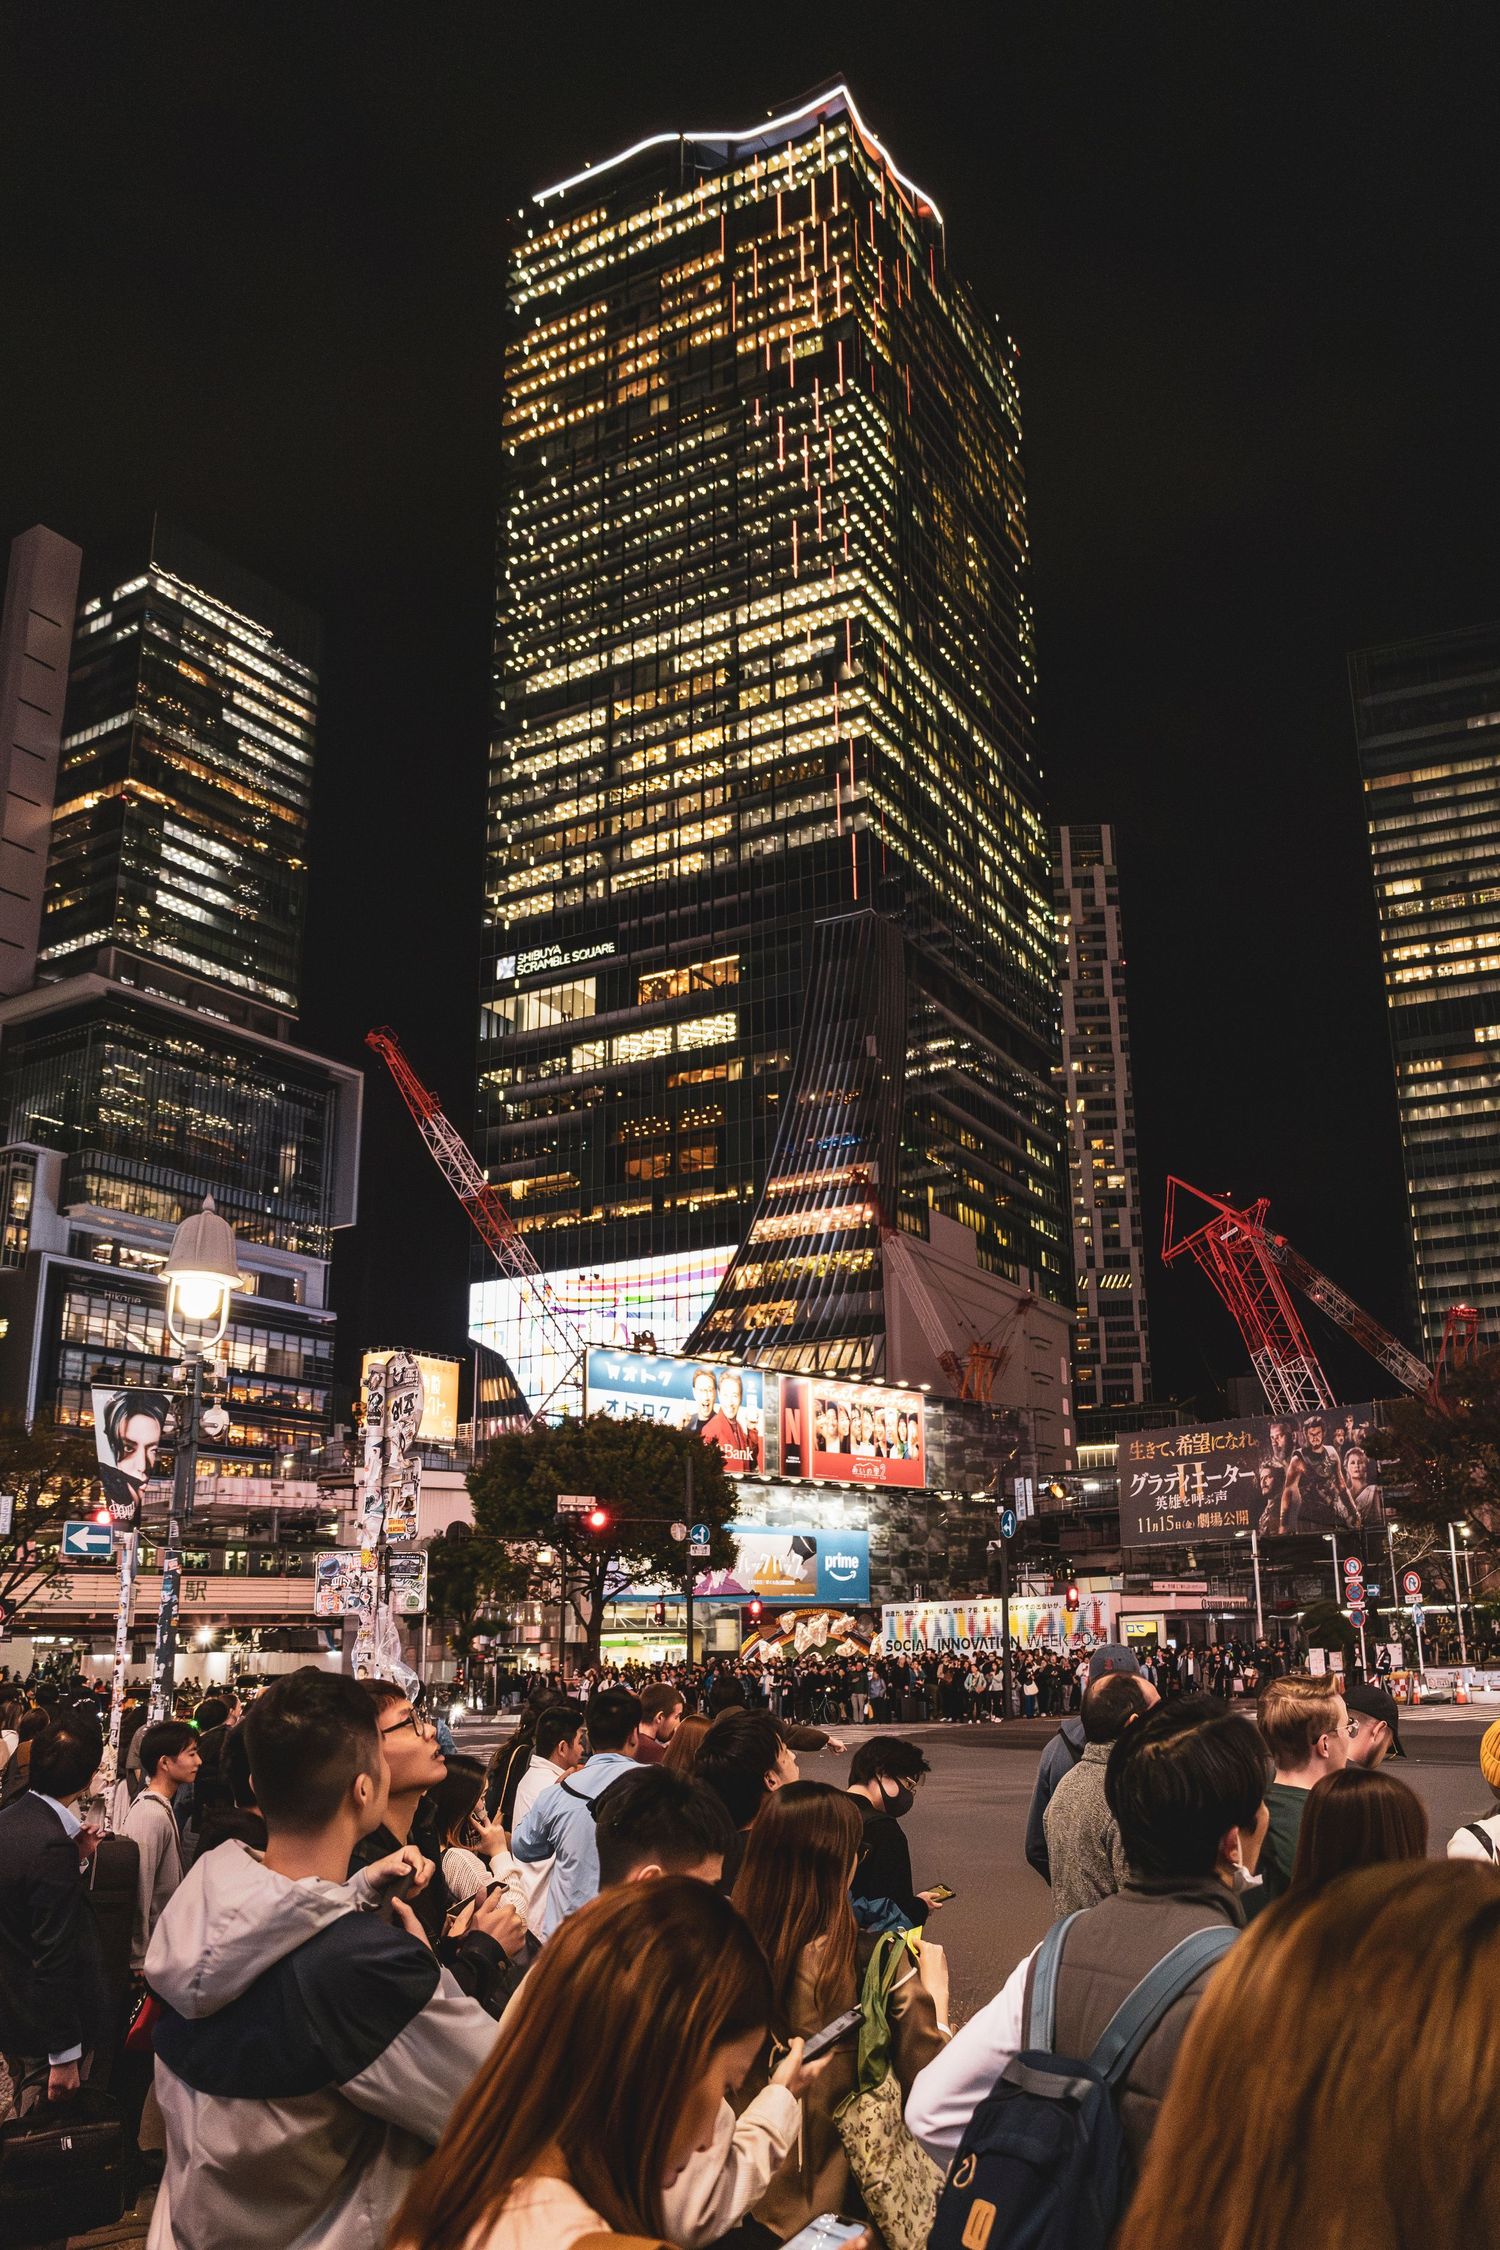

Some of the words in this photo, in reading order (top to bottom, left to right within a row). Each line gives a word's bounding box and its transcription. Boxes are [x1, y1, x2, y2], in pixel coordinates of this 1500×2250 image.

[516, 954, 571, 976] SCRAMBLE
[572, 942, 616, 962] SQUARE
[517, 944, 562, 965] SHIBUYA
[103, 1290, 142, 1305] Hikarie
[785, 1407, 801, 1445] N
[1129, 1430, 1260, 1460] 生きて、希望になれ。
[1129, 1463, 1256, 1498] グラディエーター
[1155, 1490, 1228, 1511] 英雄を呼ぶ声
[824, 1551, 860, 1571] prime
[885, 1638, 929, 1652] SOCIAL
[1027, 1632, 1069, 1648] WEEK
[1073, 1629, 1108, 1646] 2024
